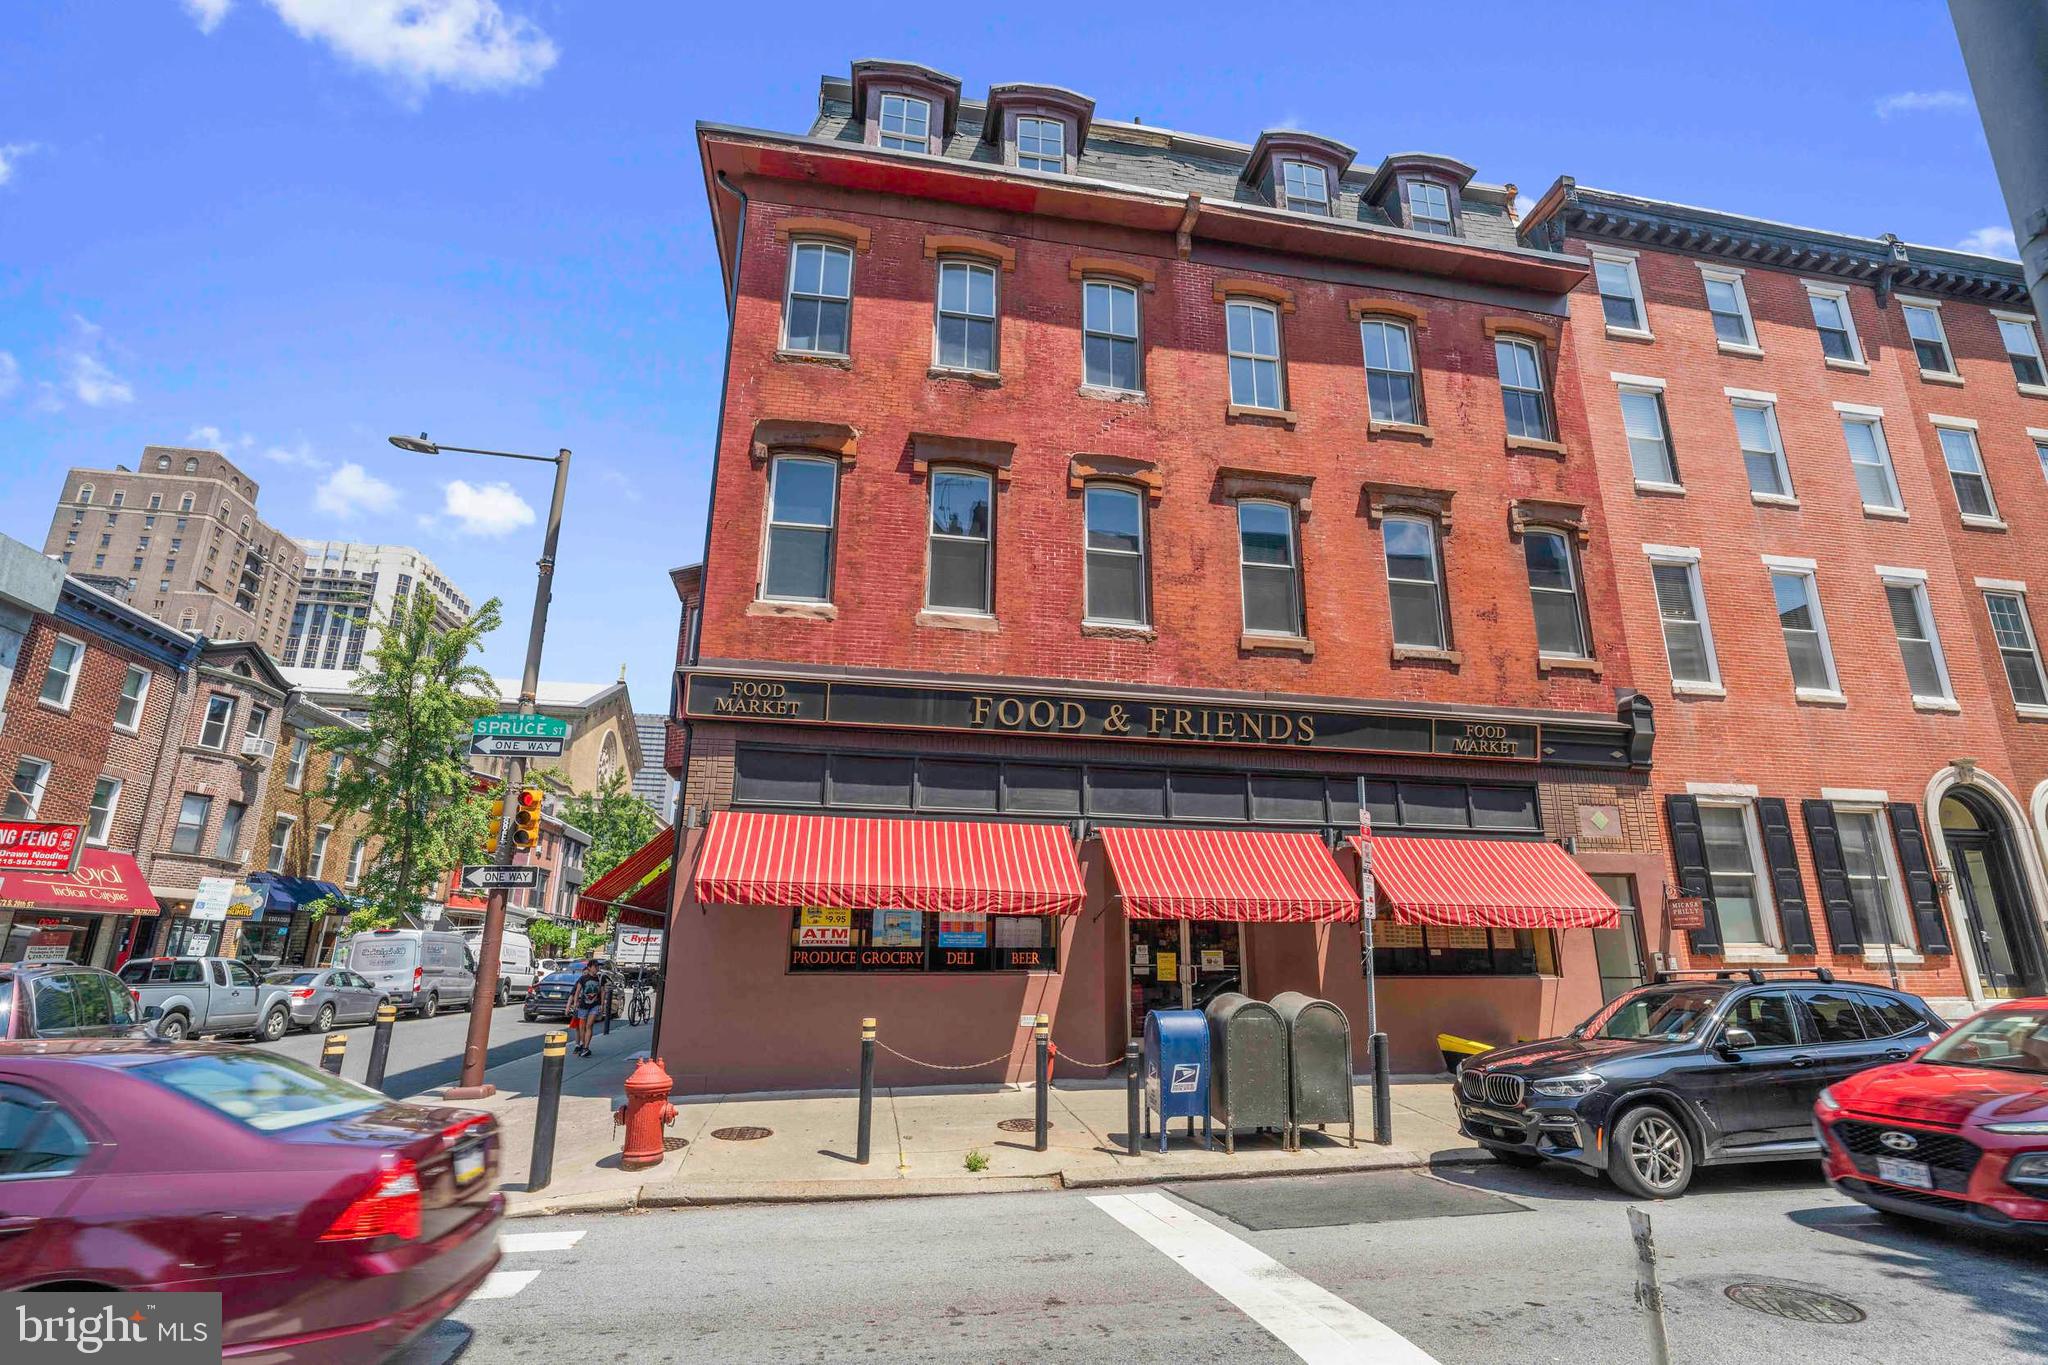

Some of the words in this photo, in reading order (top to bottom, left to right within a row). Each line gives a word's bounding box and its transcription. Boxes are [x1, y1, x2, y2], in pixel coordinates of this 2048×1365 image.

[732, 681, 786, 698] FOOD
[715, 697, 802, 715] MARKET
[971, 696, 1087, 728] FOOD
[1104, 704, 1131, 731] &
[1148, 706, 1315, 742] FRIENDS
[477, 721, 547, 735] SPRUCE
[552, 726, 563, 735] ST
[1465, 725, 1507, 738] FOOD
[495, 741, 519, 750] ONE
[528, 742, 553, 750] WAY
[1454, 739, 1519, 754] MARKET
[19, 831, 58, 847] FENG
[32, 851, 69, 860] Noodles
[484, 872, 506, 882] ONE
[509, 872, 530, 882] WAY
[51, 885, 87, 898] Indian
[825, 915, 846, 923] $9.95
[630, 934, 659, 944] Ryder
[802, 928, 849, 939] ATM
[793, 951, 857, 964] PRODUCE
[861, 951, 925, 964] GROCERY
[946, 951, 976, 965] DELI
[1011, 951, 1040, 965] BEER
